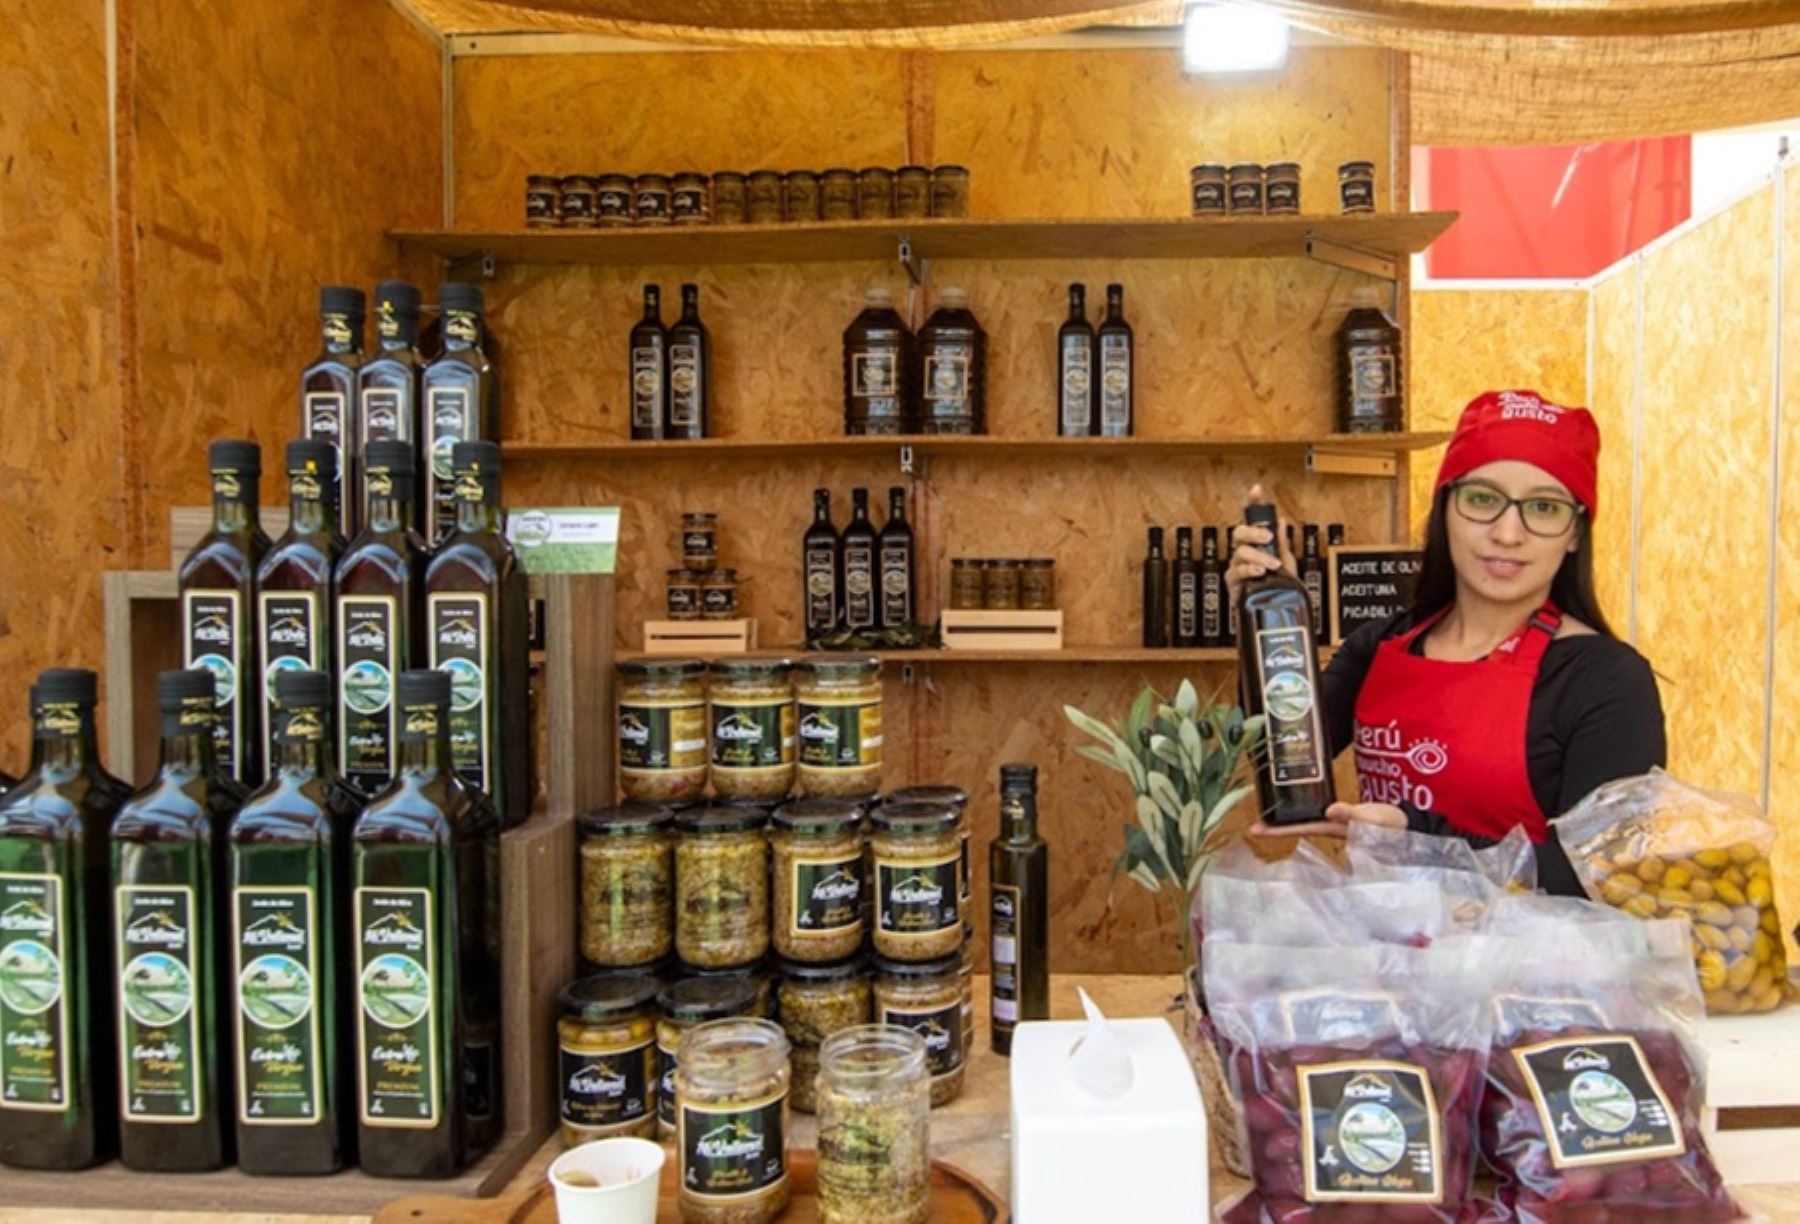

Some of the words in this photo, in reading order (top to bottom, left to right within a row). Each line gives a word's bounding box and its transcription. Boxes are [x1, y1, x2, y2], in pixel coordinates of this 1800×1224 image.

[1341, 561, 1378, 575] ACEITE
[1380, 560, 1397, 575] DE
[1341, 582, 1398, 597] ACEITUNA
[1354, 719, 1401, 749] erú
